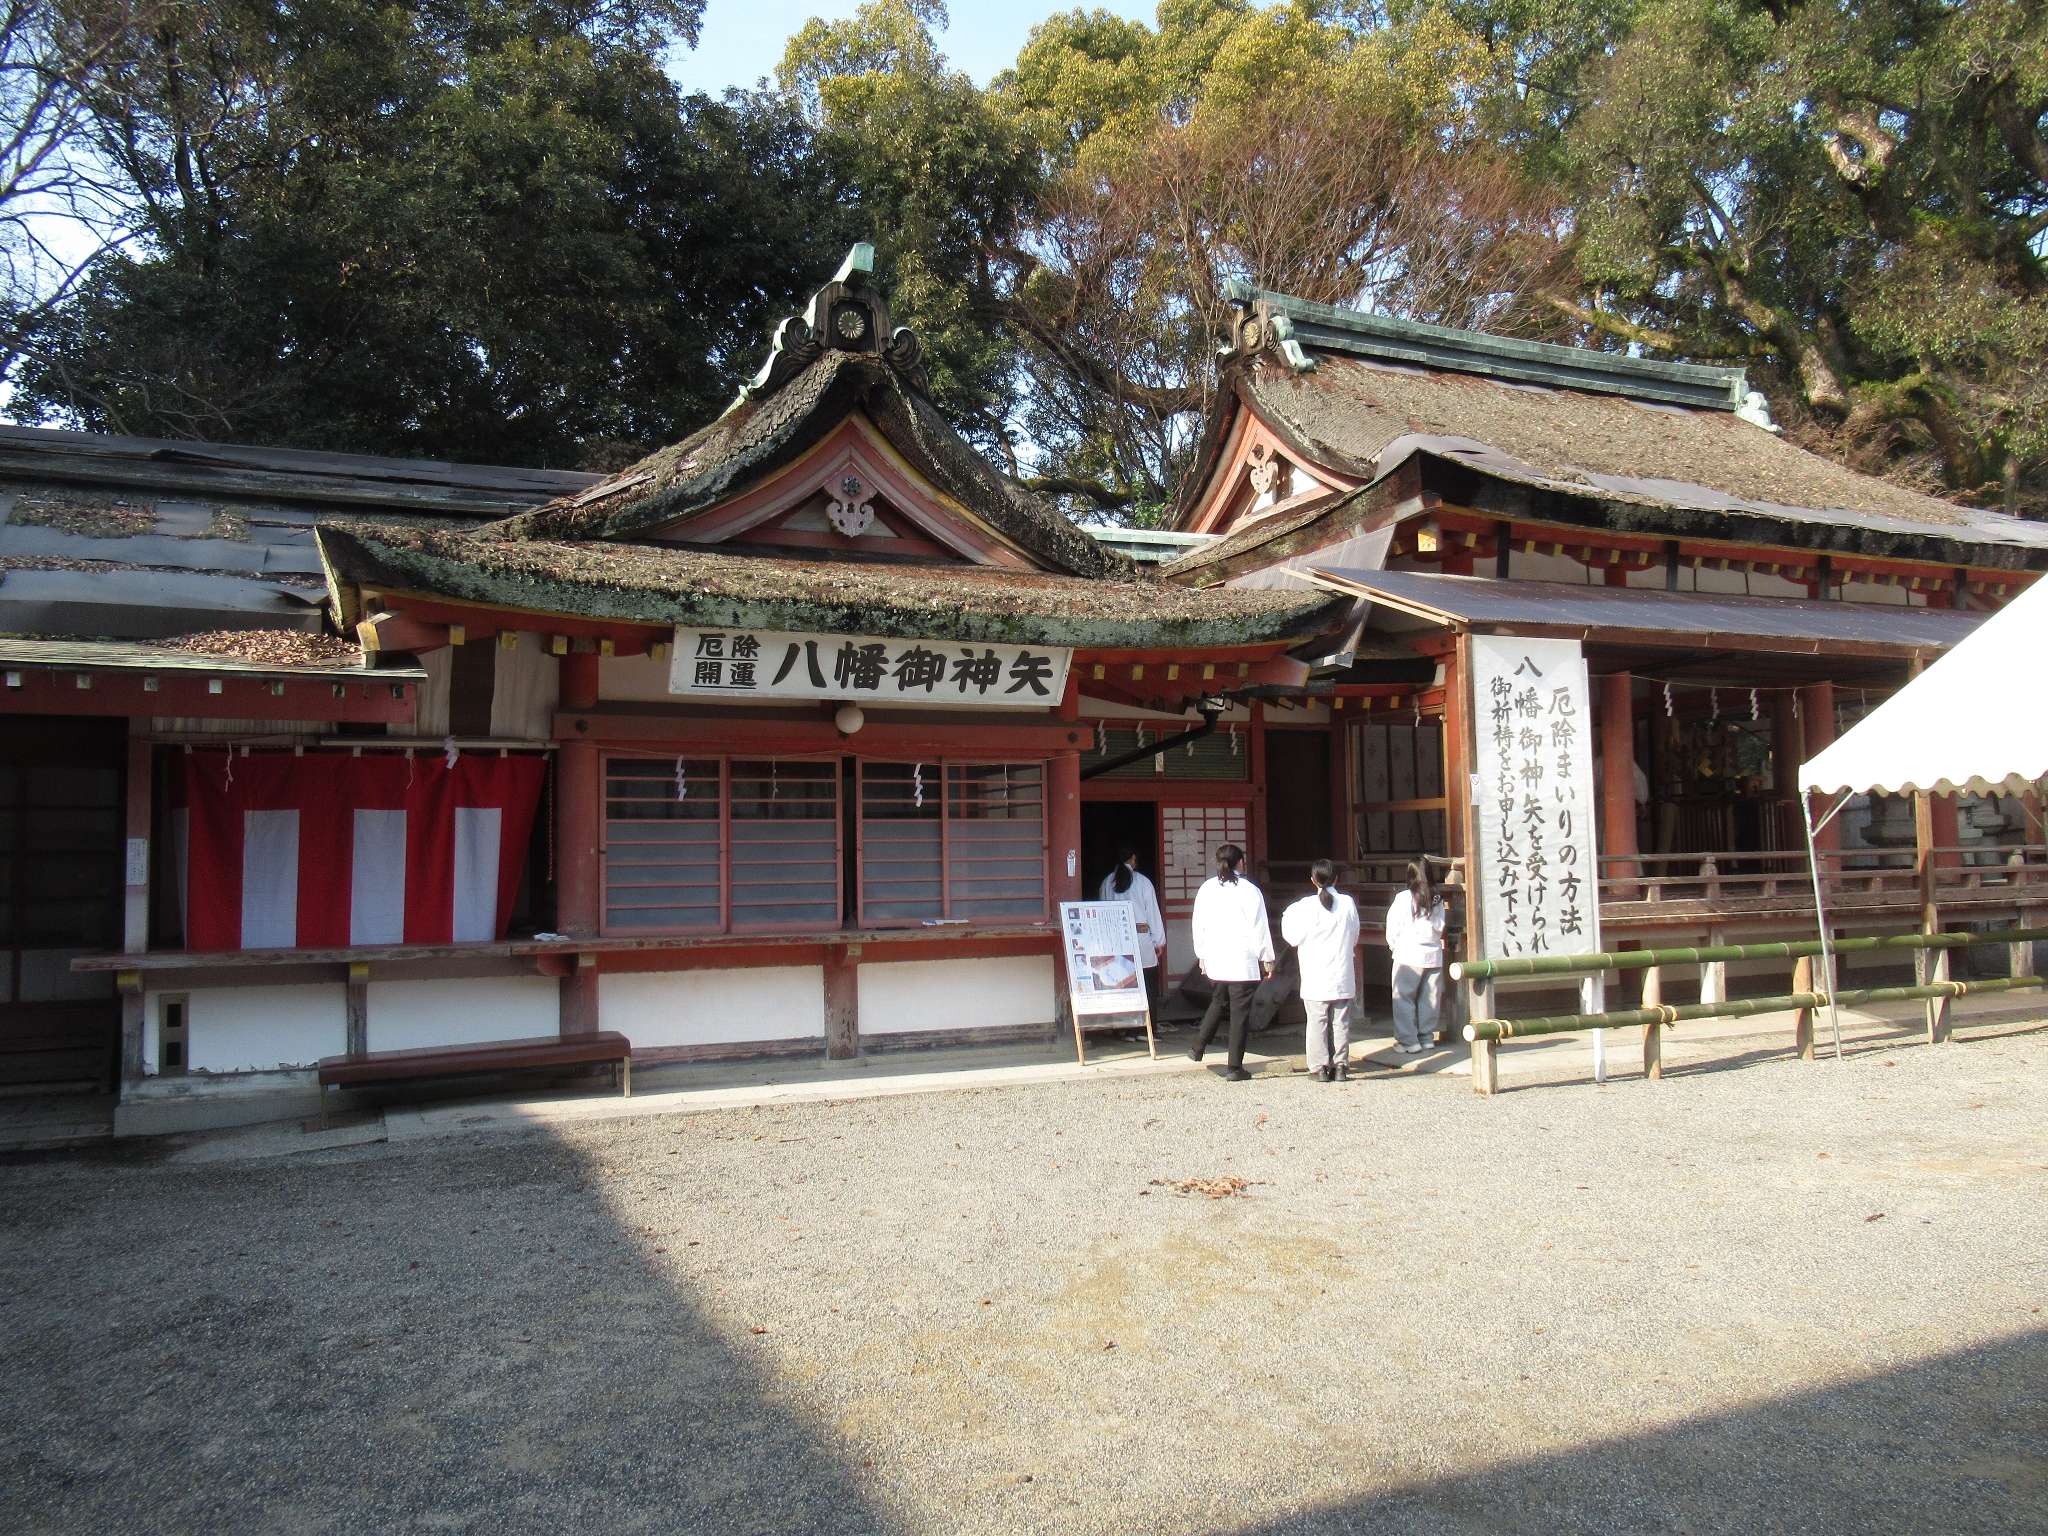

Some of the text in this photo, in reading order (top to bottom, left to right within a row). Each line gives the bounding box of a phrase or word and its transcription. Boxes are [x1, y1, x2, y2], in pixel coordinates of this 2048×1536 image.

[695, 661, 757, 686] 開運
[696, 633, 761, 658] 厄除
[772, 640, 1053, 696] 八幡御神矢
[1491, 676, 1522, 957] 御祈祷をお申し込み下さい
[1514, 656, 1549, 951] 八幡御神矢を受けられ
[1548, 687, 1582, 935] 厄除まいりの方法
